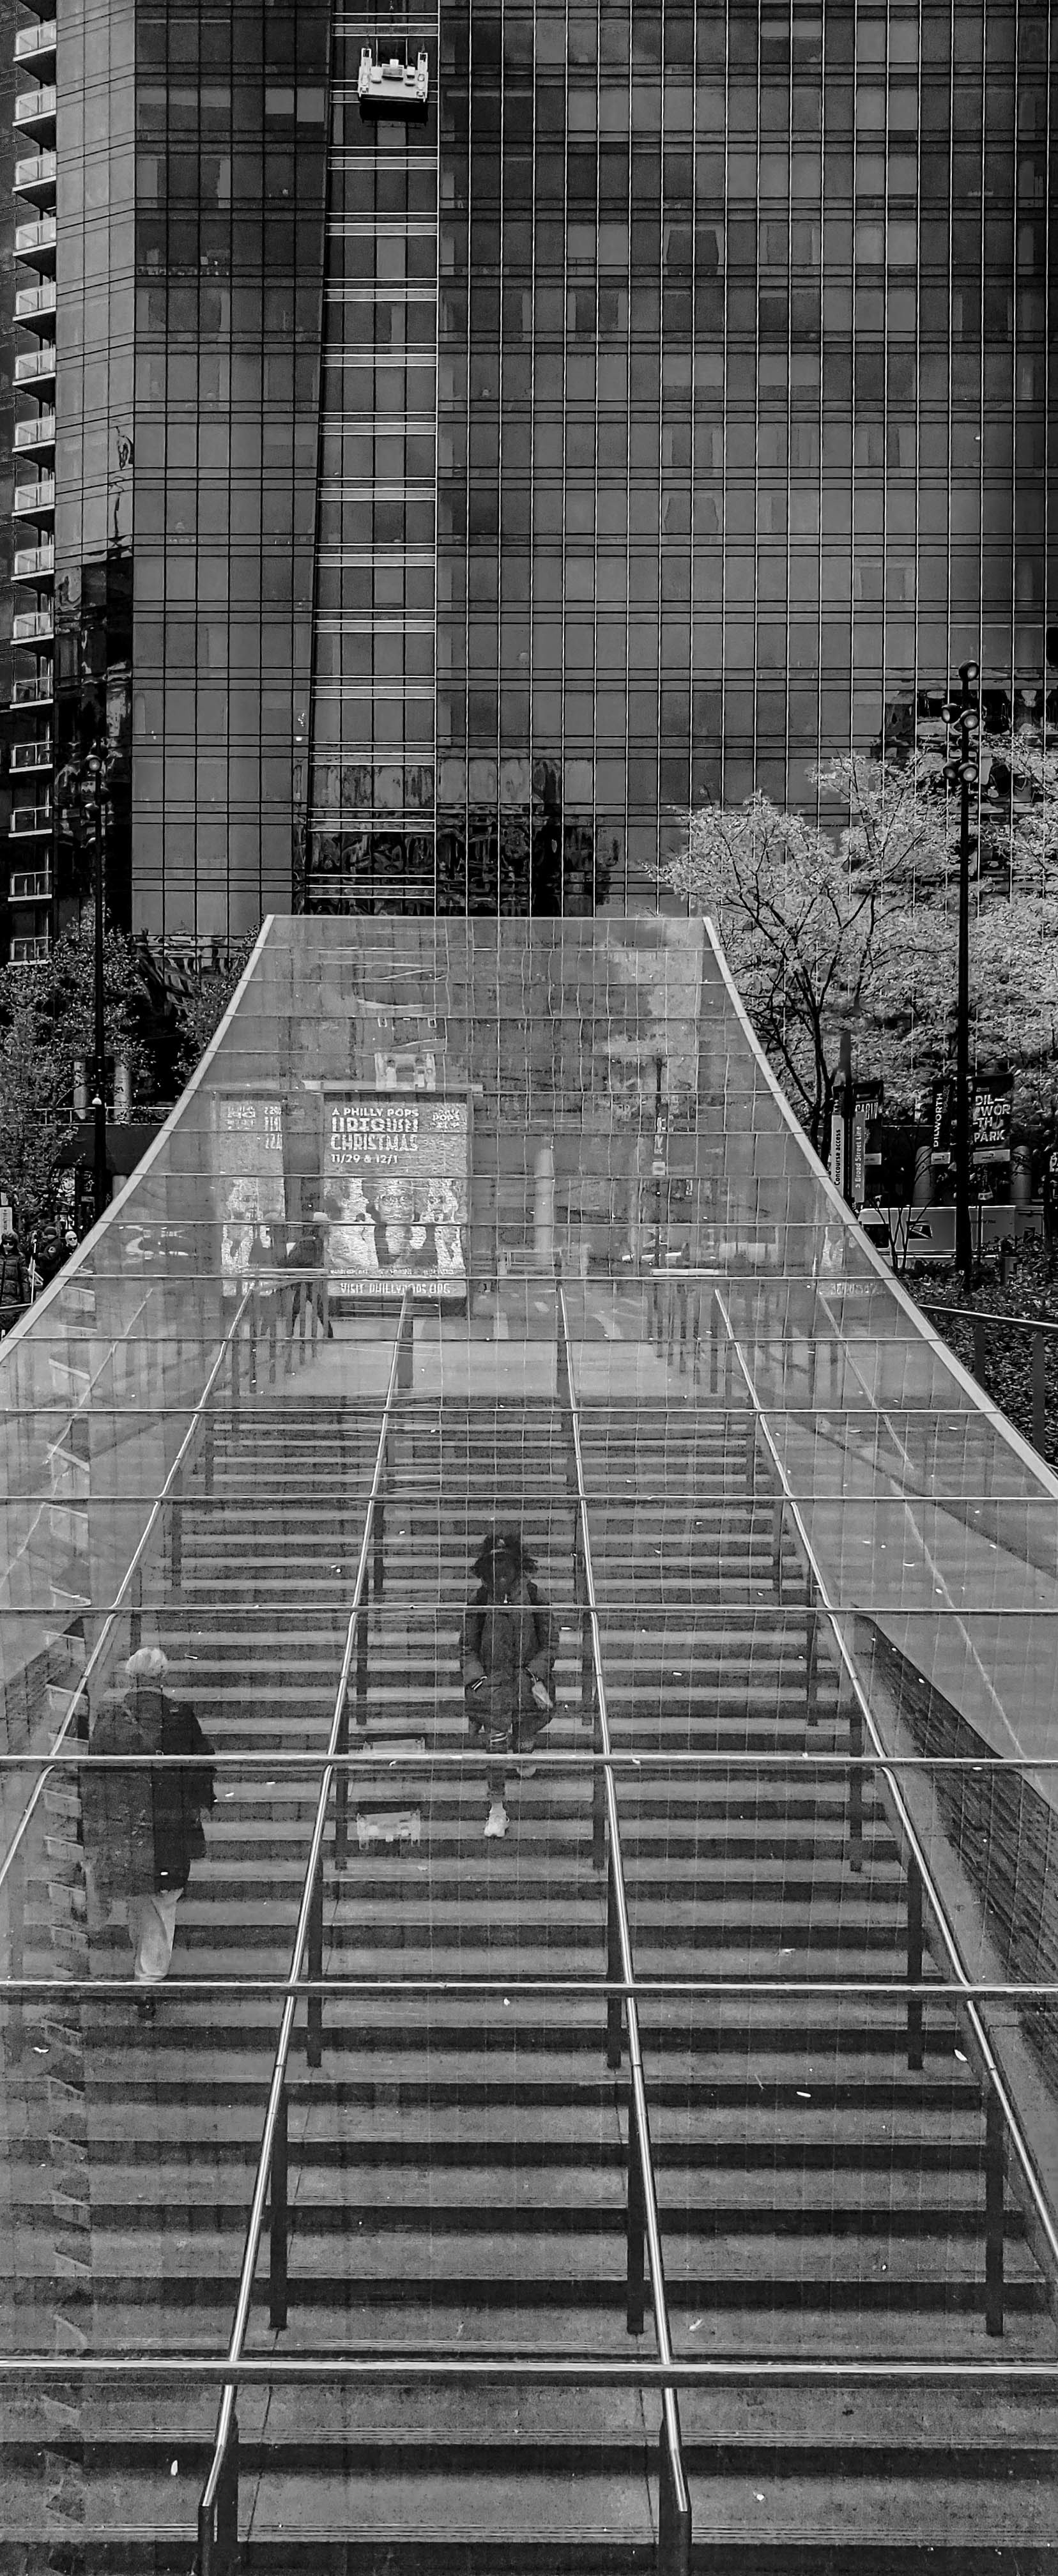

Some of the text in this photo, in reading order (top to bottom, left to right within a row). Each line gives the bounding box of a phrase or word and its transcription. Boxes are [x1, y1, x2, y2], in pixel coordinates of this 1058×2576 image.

[332, 1107, 420, 1117] A PHILLY POPS
[981, 1104, 1011, 1116] WOR
[933, 1093, 942, 1147] DILWORTH
[330, 1133, 418, 1151] CHRISTMAS
[974, 1130, 1006, 1142] PARK
[331, 1154, 399, 1165] 11/29 & 12/1
[341, 1282, 364, 1294] VISIT
